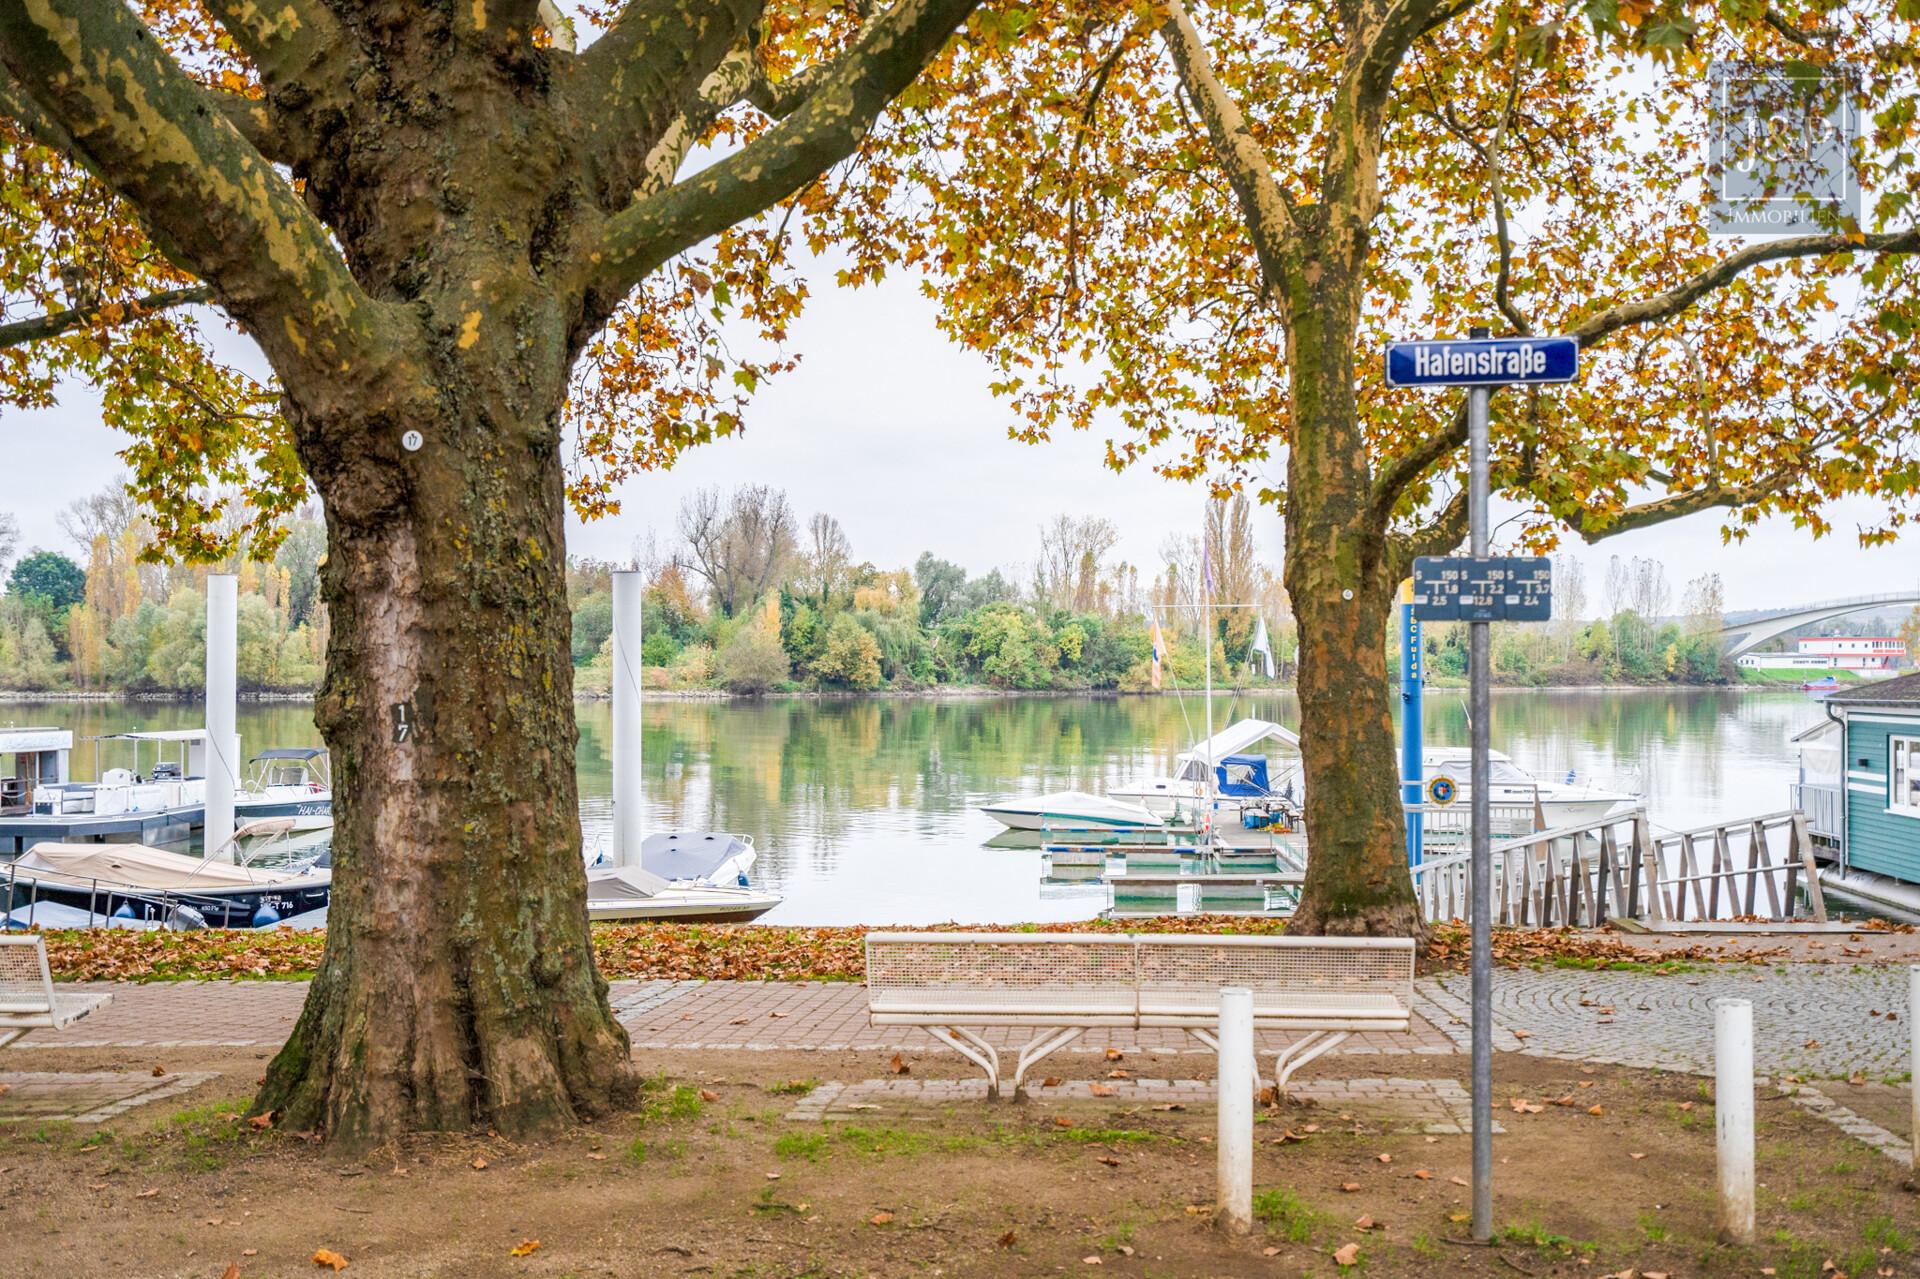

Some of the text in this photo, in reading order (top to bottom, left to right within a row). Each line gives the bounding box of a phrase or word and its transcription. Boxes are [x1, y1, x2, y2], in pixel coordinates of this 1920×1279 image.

[1414, 344, 1547, 378] Hafenstraße
[1415, 570, 1458, 580] S 150
[1461, 570, 1505, 580] S 150
[1507, 570, 1550, 580] S 150
[1489, 584, 1504, 594] 2.2
